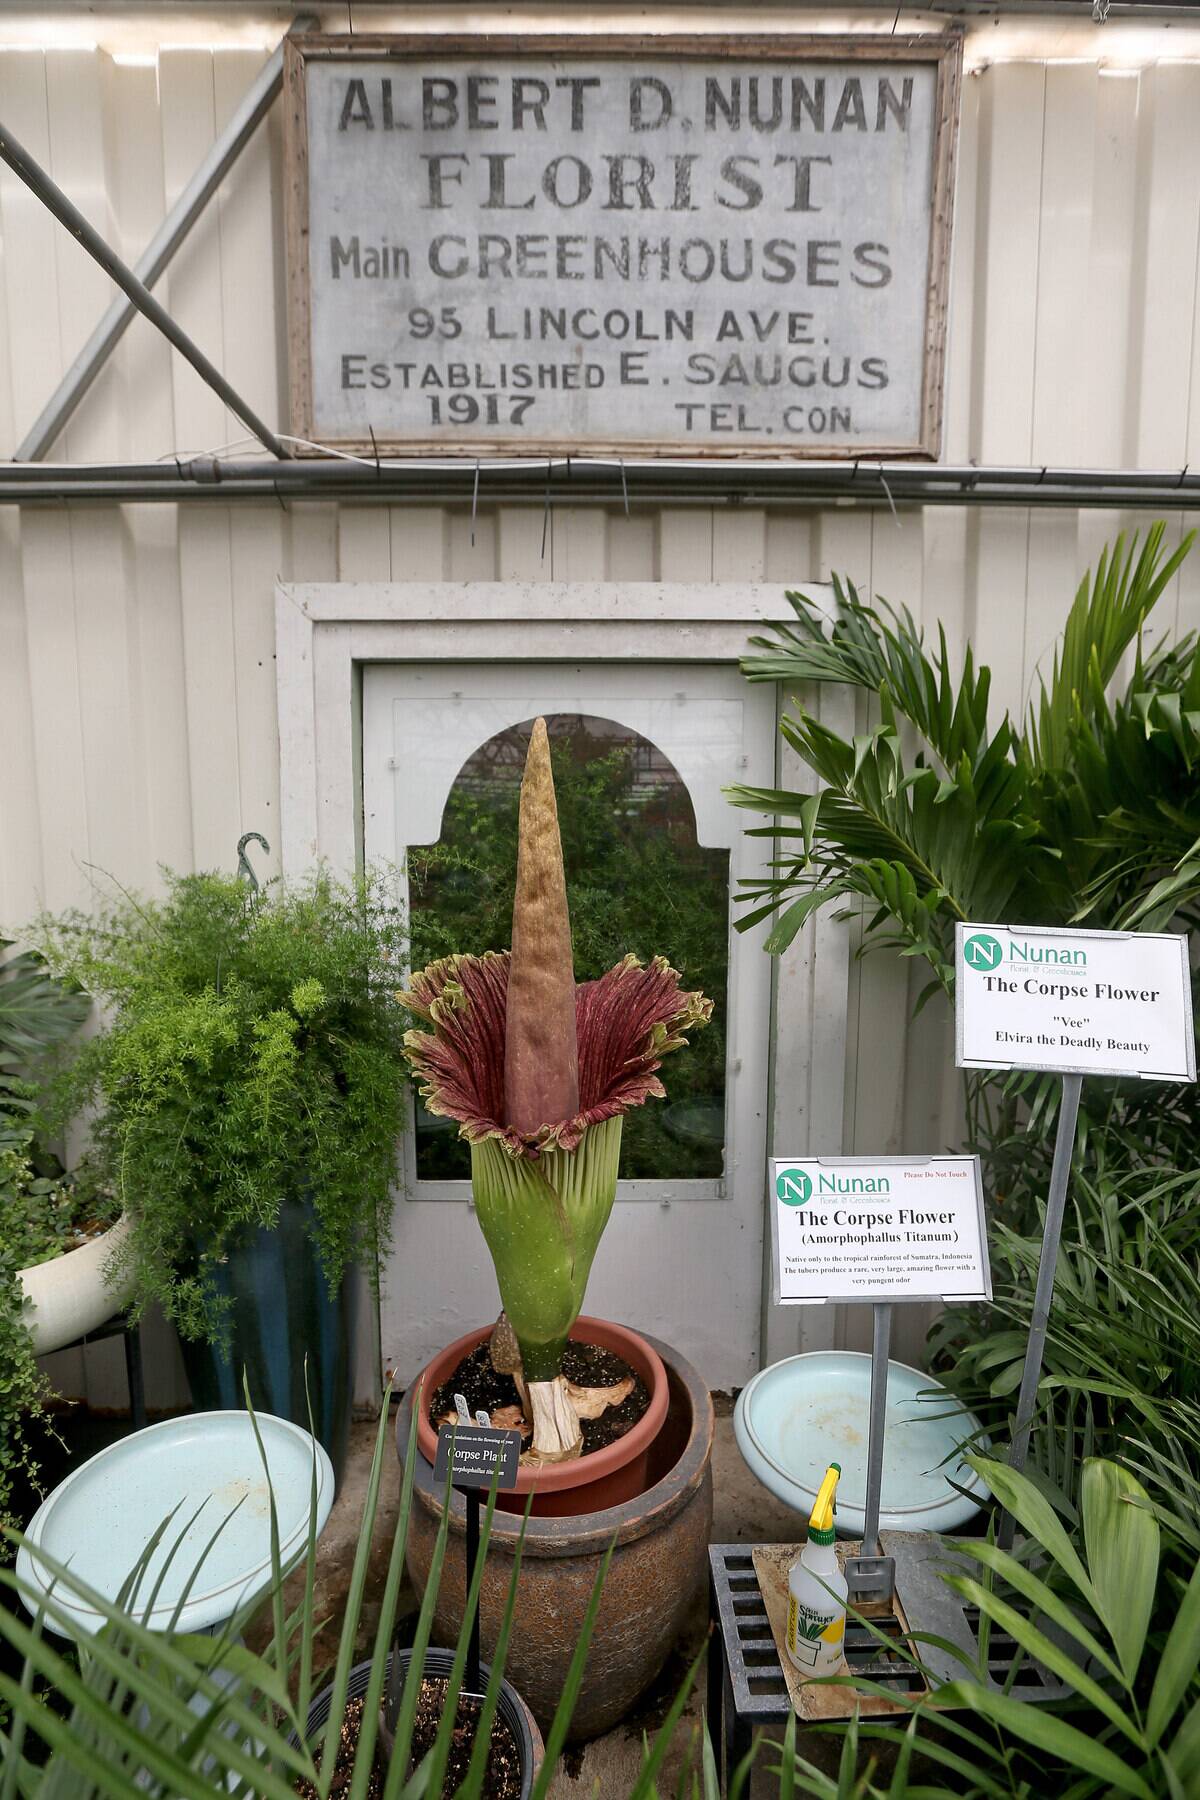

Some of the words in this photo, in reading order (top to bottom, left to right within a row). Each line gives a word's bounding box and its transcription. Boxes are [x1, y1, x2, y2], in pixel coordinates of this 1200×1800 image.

[338, 76, 600, 132] ALBERT
[703, 76, 914, 133] NUNAN
[419, 153, 832, 212] FLORIST
[329, 235, 410, 280] Main
[427, 234, 893, 288] GREENHOUSES
[408, 307, 462, 340] 95
[487, 307, 694, 341] LINCOLN
[716, 310, 830, 344] AVE.
[620, 352, 669, 386] E.
[683, 353, 889, 390] SAUGUS
[426, 394, 536, 426] 1917
[1009, 941, 1087, 965] Nunan
[983, 976, 1018, 993] The
[1024, 979, 1088, 1000] Corpse
[1095, 984, 1160, 1002] Flower
[1053, 1015, 1090, 1028] "Vee"
[995, 1031, 1033, 1043] Elvira
[1037, 1034, 1056, 1045] the
[1060, 1035, 1103, 1051] Deadly
[1107, 1038, 1151, 1055] Beauty
[819, 1173, 890, 1193] Nunan
[796, 1211, 828, 1226] The
[834, 1210, 893, 1229] Corpse
[898, 1209, 956, 1225] Flower
[802, 1231, 901, 1246] (Amorphophallus
[904, 1230, 959, 1243] Titanum)
[820, 1266, 847, 1275] produce
[886, 1265, 906, 1273] large,
[843, 1255, 869, 1263] tropical
